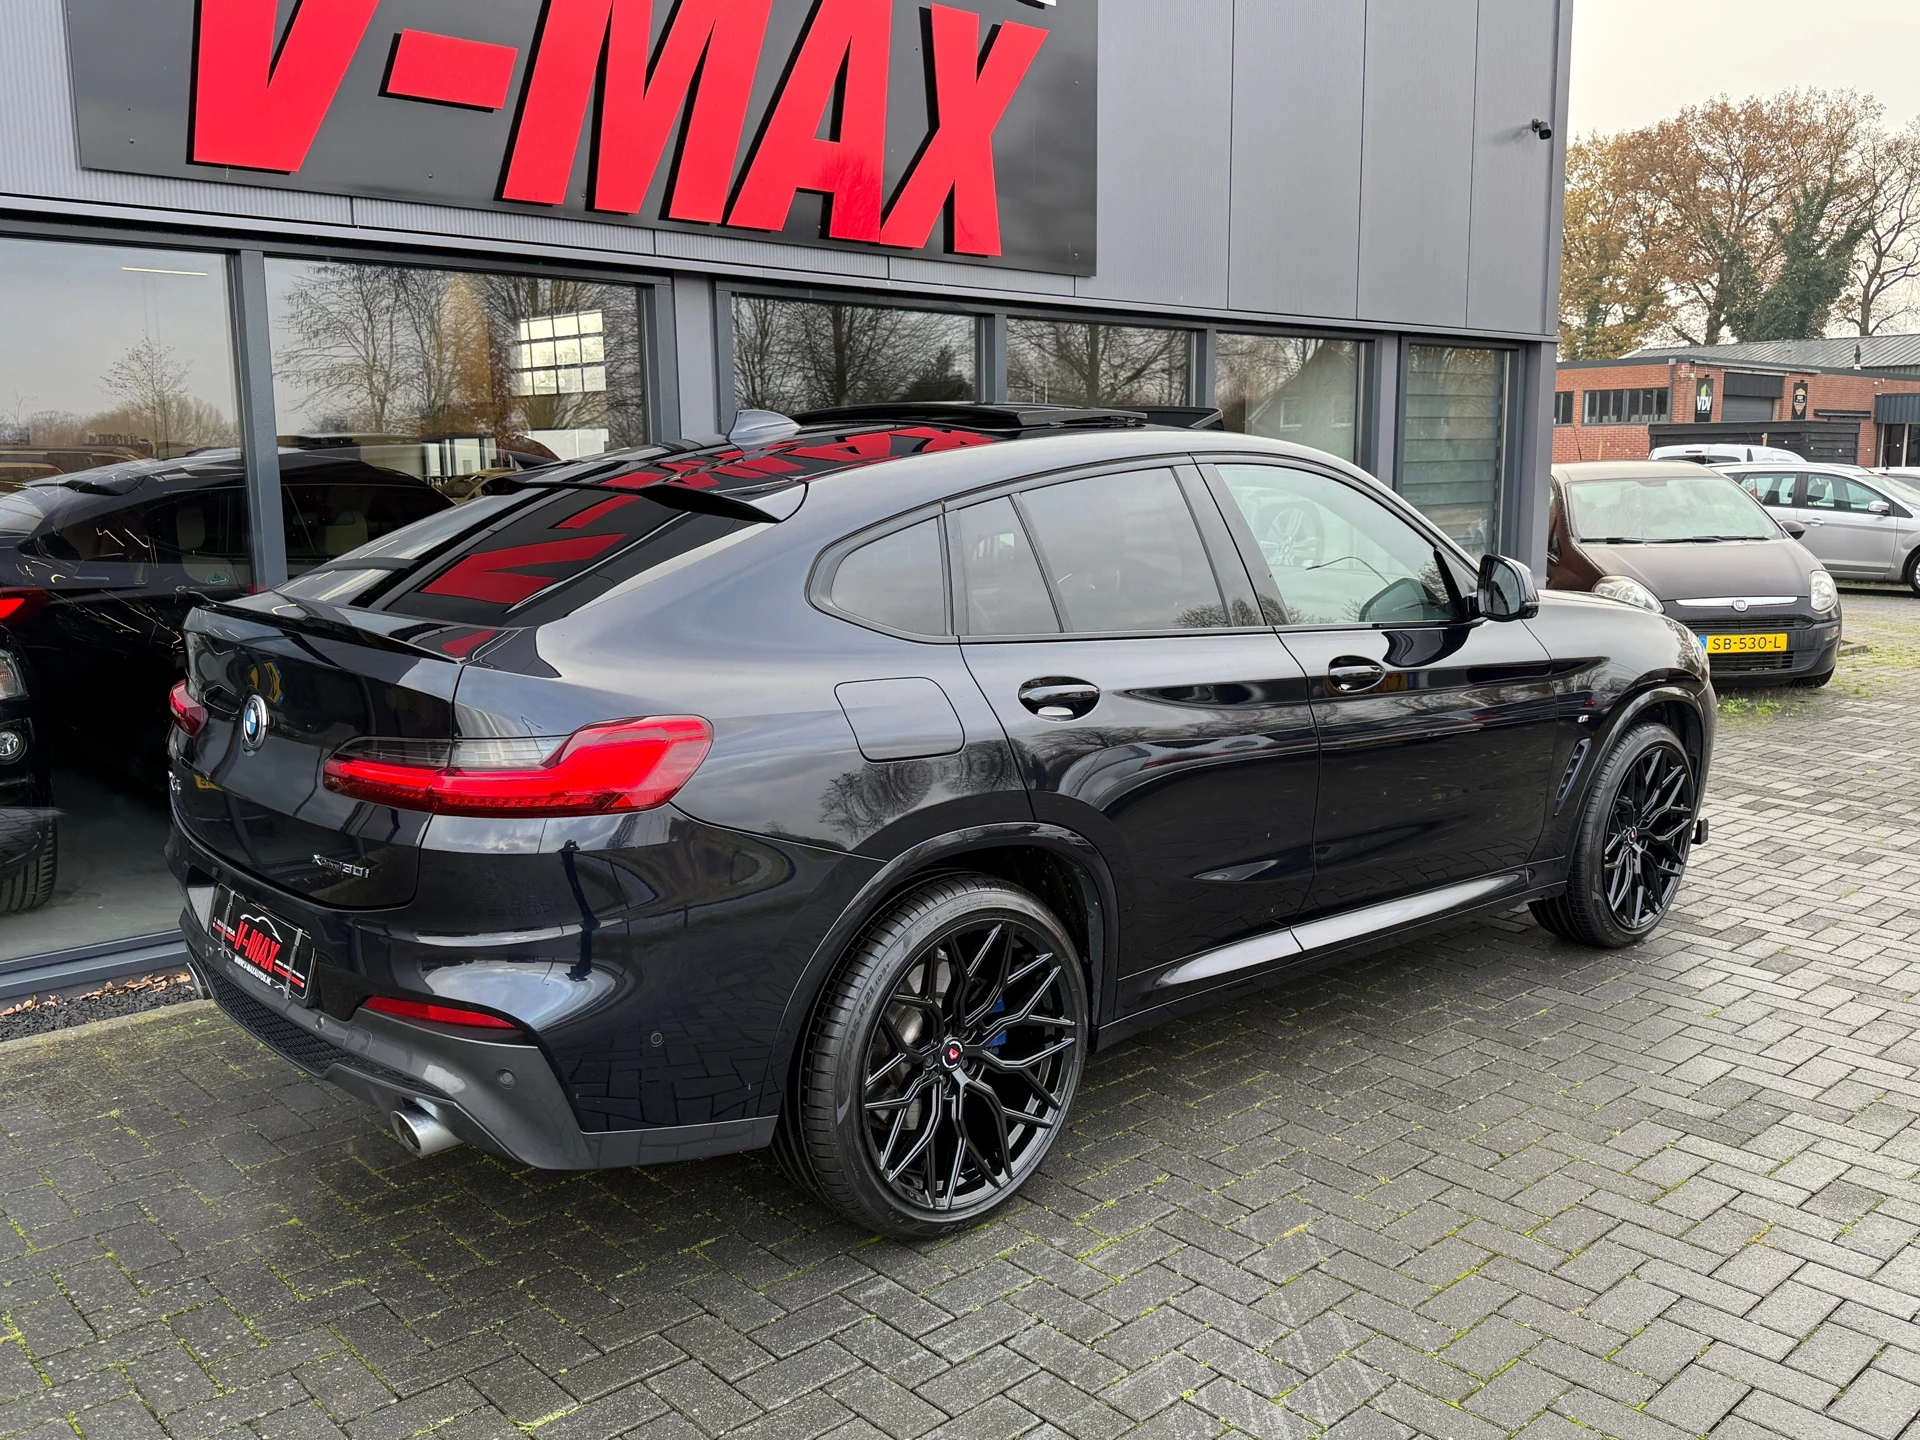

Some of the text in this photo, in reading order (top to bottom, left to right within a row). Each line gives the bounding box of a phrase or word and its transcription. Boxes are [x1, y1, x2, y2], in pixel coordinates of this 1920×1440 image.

[192, 0, 1049, 257] V-MAX
[1696, 396, 1712, 411] VDV
[1712, 636, 1782, 650] SB-530-L
[234, 920, 281, 973] V-MAX
